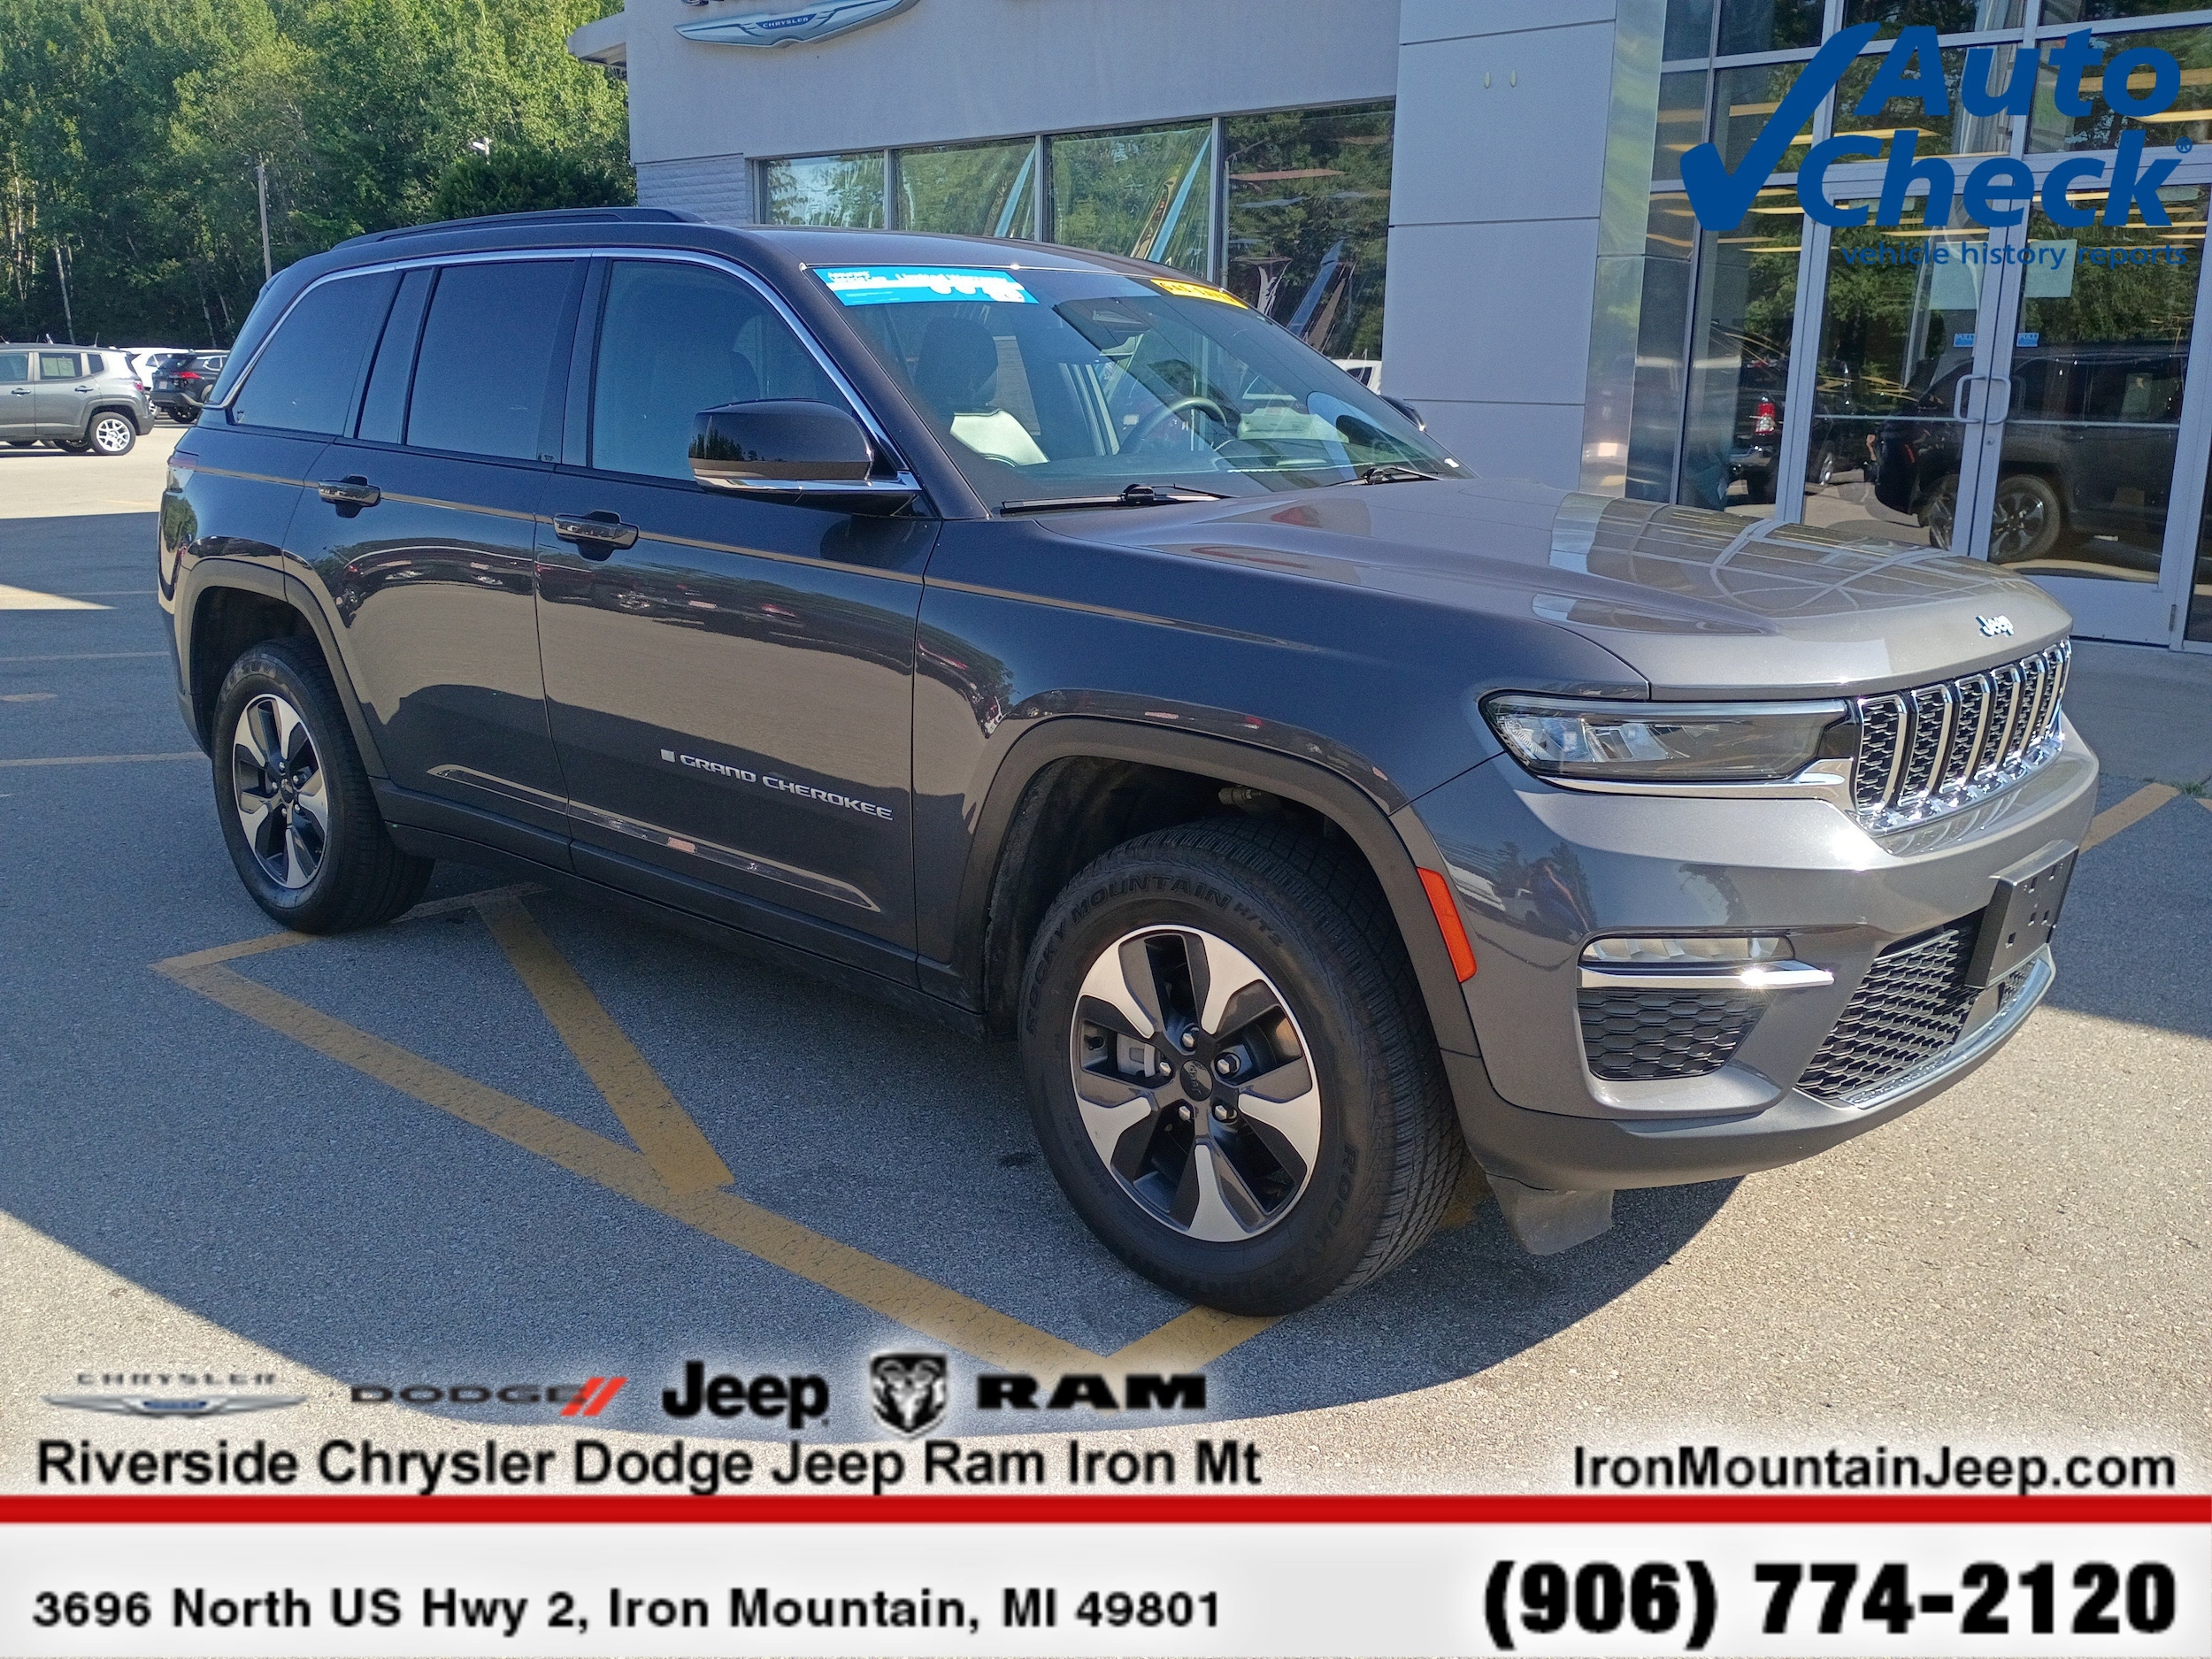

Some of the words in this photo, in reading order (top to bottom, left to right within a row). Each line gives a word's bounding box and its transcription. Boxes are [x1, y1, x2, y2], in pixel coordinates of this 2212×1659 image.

[762, 17, 809, 27] CHRYSLER
[1975, 615, 2015, 637] Jeep
[680, 754, 757, 783] GRAND
[762, 775, 894, 821] CHEROKEE
[1071, 874, 1233, 925] MOUNTAIN
